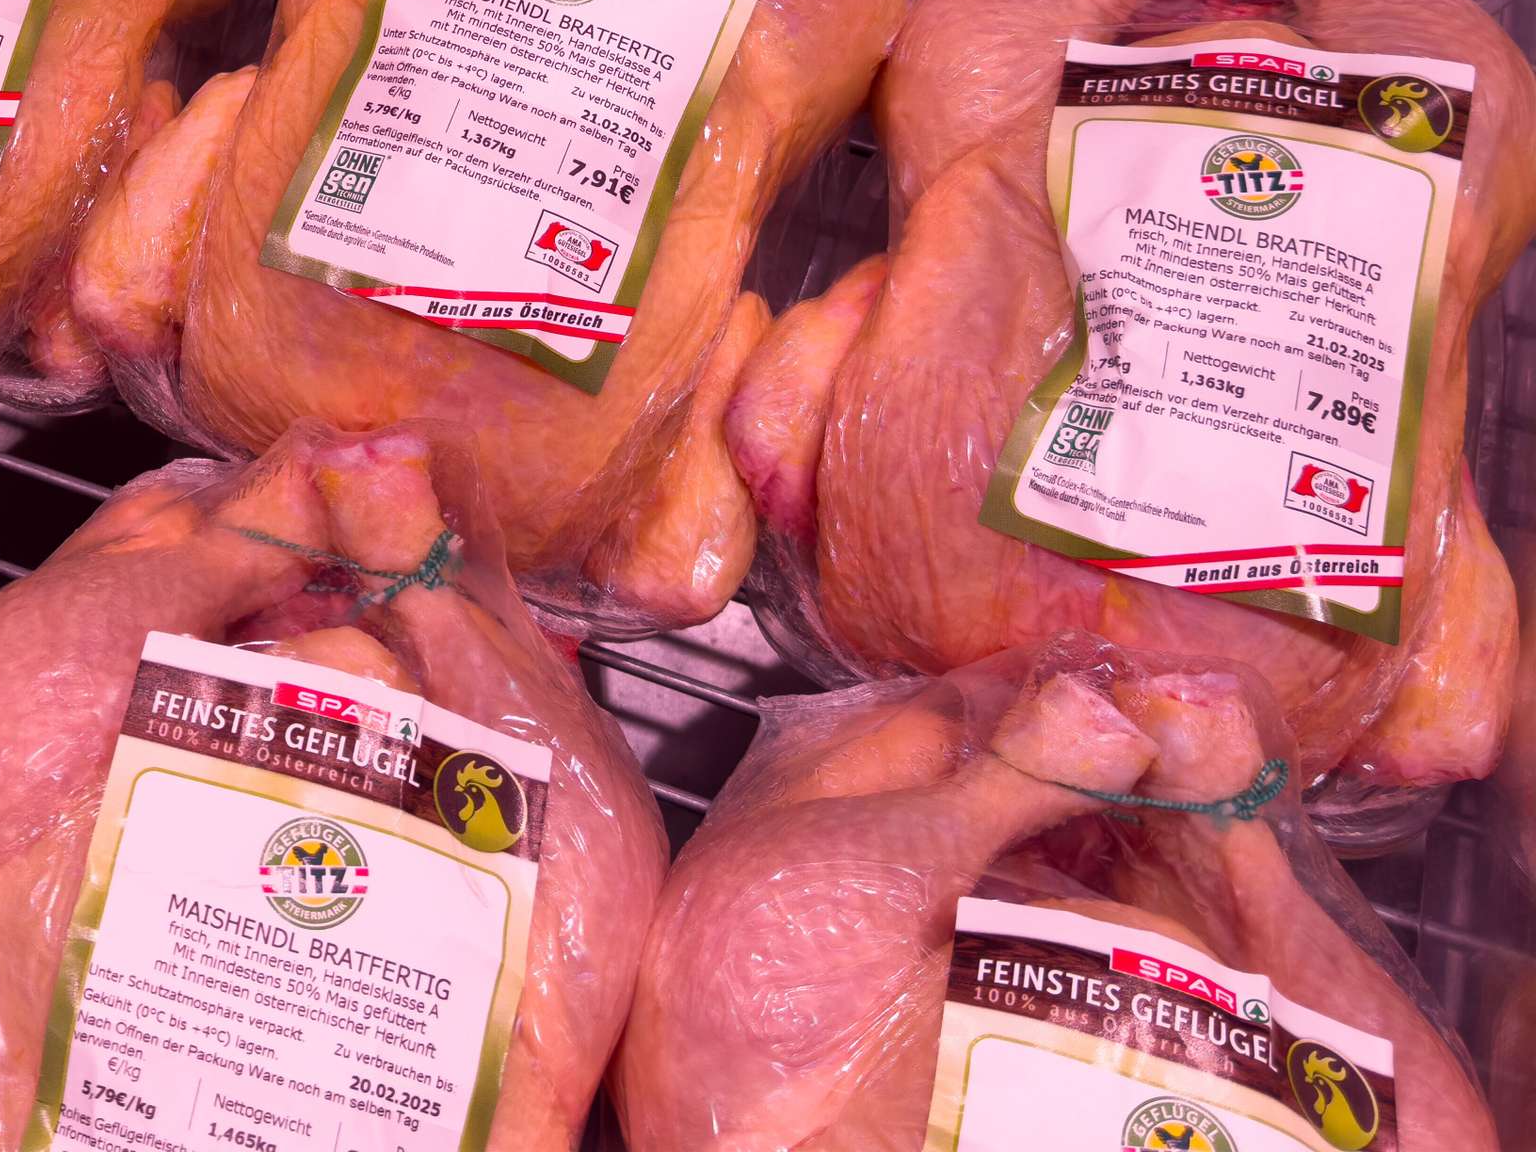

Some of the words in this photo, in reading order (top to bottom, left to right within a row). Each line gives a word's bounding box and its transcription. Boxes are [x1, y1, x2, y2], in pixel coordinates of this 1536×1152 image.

[558, 15, 674, 72] BRATFERTIG
[1081, 73, 1200, 94] FEINSTES
[1208, 74, 1344, 109] GEFLÜGEL
[363, 100, 422, 125] 5,79€/kg
[468, 109, 547, 147] Nettogewicht
[580, 108, 654, 152] 21.02.2025
[335, 147, 382, 175] OHNE
[460, 128, 517, 160] 1,367kg
[568, 158, 635, 205] 7,91€
[1217, 172, 1287, 194] TITZ
[1125, 208, 1248, 246] MAISHENDL
[1256, 232, 1382, 281] BRATFERTIG
[427, 298, 478, 319] Hendl
[481, 303, 514, 318] aus
[519, 301, 604, 329] Österreich
[1183, 349, 1277, 381] Nettogewicht
[1306, 333, 1385, 372] 21.02.2025
[1180, 371, 1246, 398] 1,363kg
[1169, 408, 1286, 445] Packungsrückseite.
[1306, 391, 1376, 434] 7,89€
[296, 691, 388, 730] SPAR
[152, 691, 276, 742] FEINSTES
[285, 724, 422, 787] GEFLÜGEL
[272, 823, 351, 856] GEFLÜGEL
[284, 898, 348, 921] STEIERMARK
[168, 894, 301, 954] MAISHENDL
[308, 937, 453, 1000] BRATFERTIG
[323, 969, 426, 1013] Handelsklasse
[972, 986, 1037, 1012] 100%
[1138, 958, 1235, 1010] SPAR
[977, 958, 1121, 1012] FEINSTES
[1132, 994, 1279, 1073] GEFLÜGEL
[355, 1049, 433, 1083] verbrauchen
[81, 1079, 157, 1120] 5,79€/kg
[214, 1093, 313, 1136] Nettogewicht
[349, 1075, 441, 1117] 20.02.2025
[1133, 1104, 1219, 1143] GEFLÜGEL
